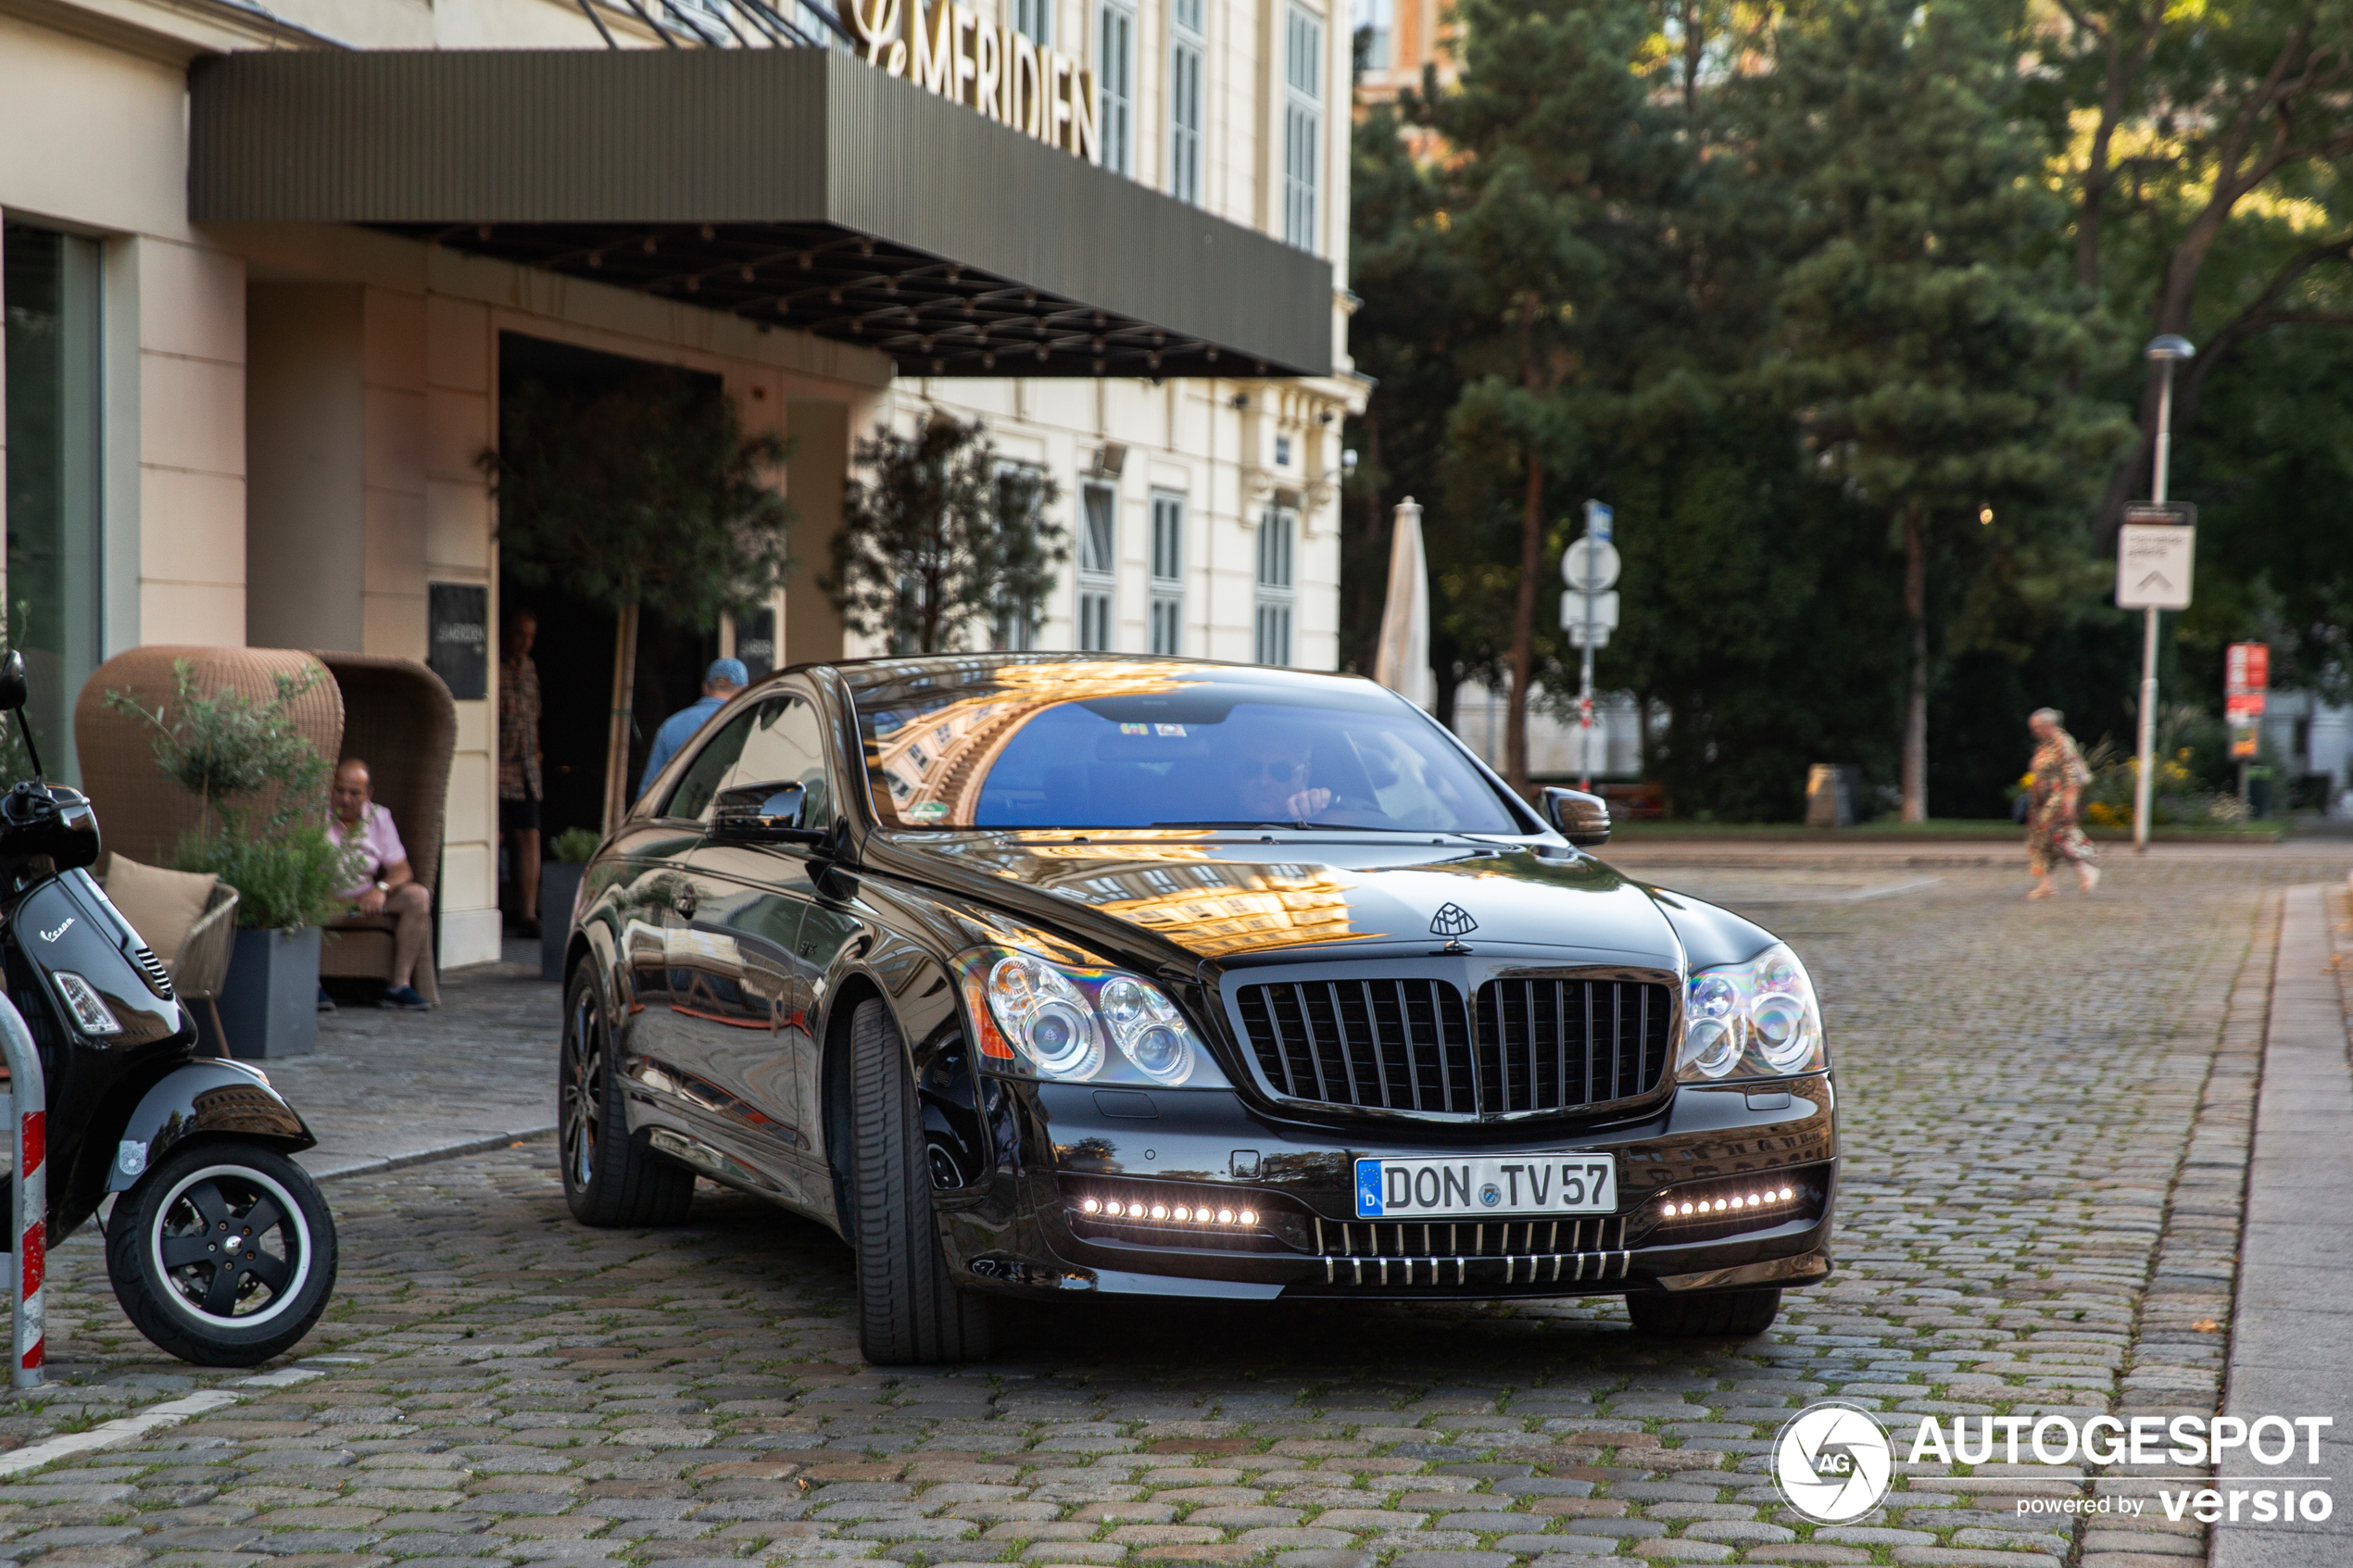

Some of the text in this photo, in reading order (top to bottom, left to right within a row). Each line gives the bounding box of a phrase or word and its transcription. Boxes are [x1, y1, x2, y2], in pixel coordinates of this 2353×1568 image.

[40, 917, 76, 943] Vespa
[1365, 1193, 1376, 1207] D
[1384, 1165, 1471, 1209] DON
